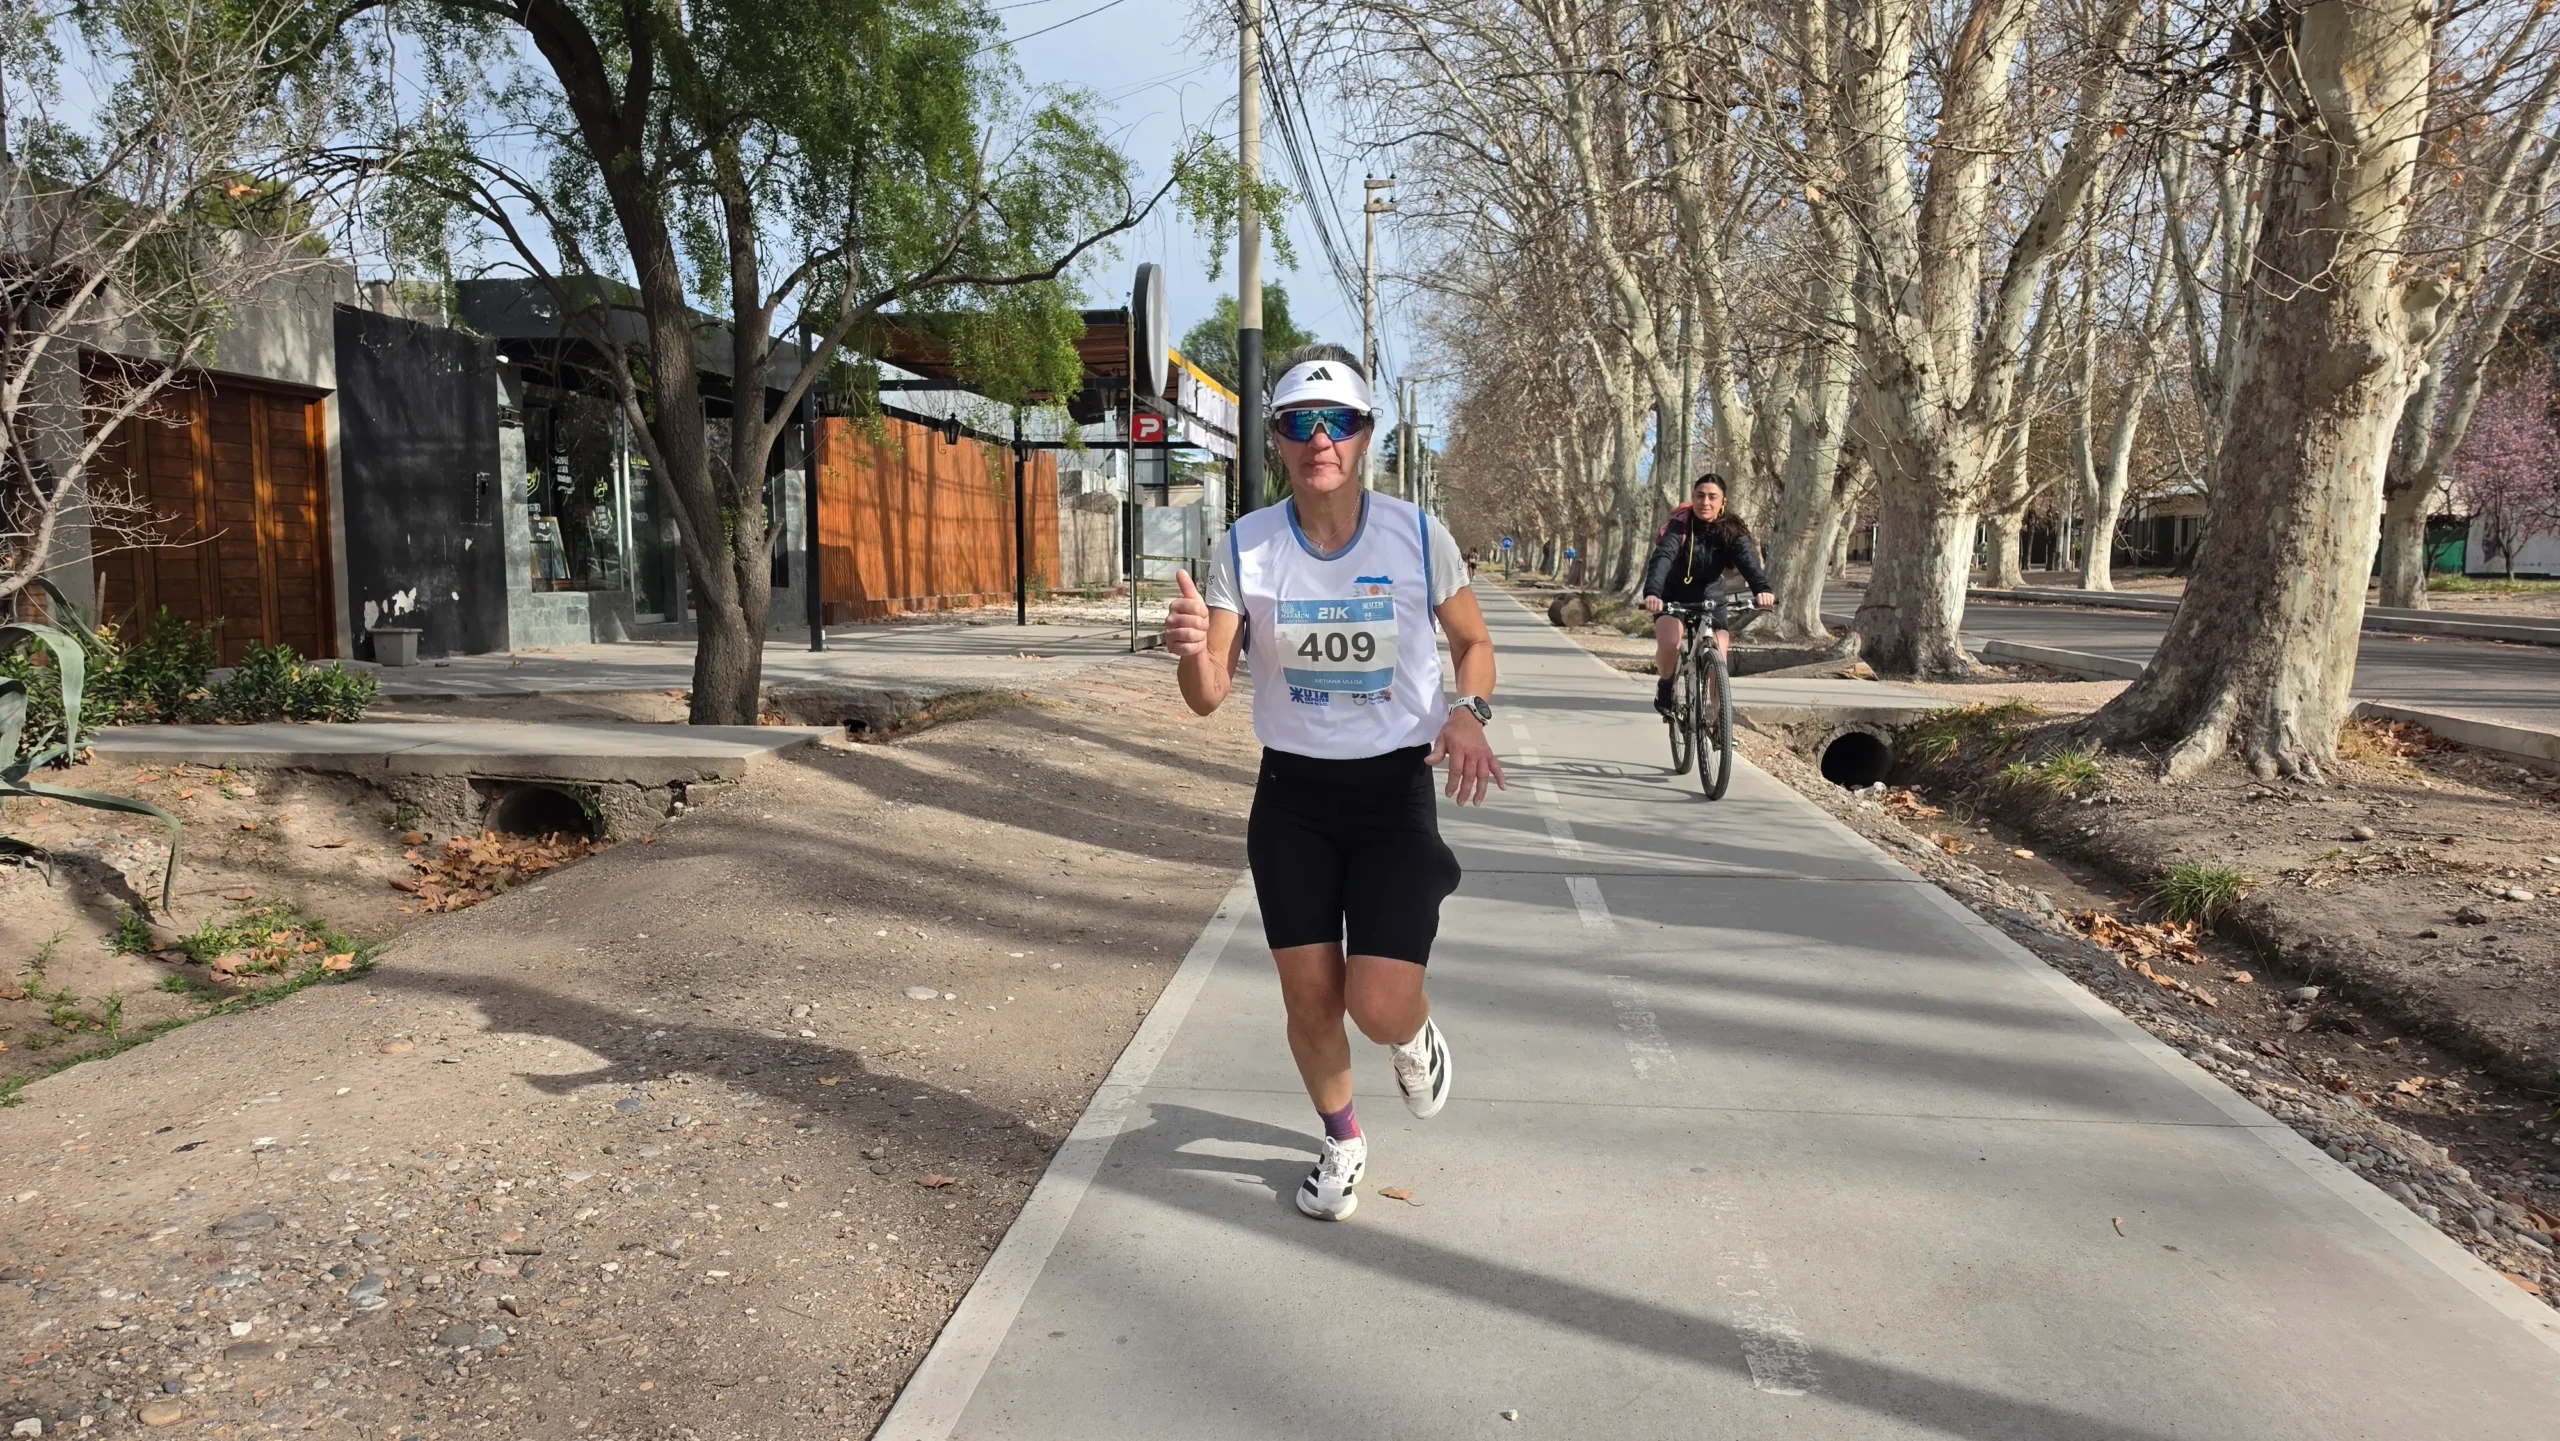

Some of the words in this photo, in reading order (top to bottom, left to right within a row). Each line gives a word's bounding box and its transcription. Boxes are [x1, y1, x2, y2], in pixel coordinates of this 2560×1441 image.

[1317, 606, 1350, 620] 21K
[1297, 631, 1376, 663] 409
[1303, 688, 1329, 699] UTN
